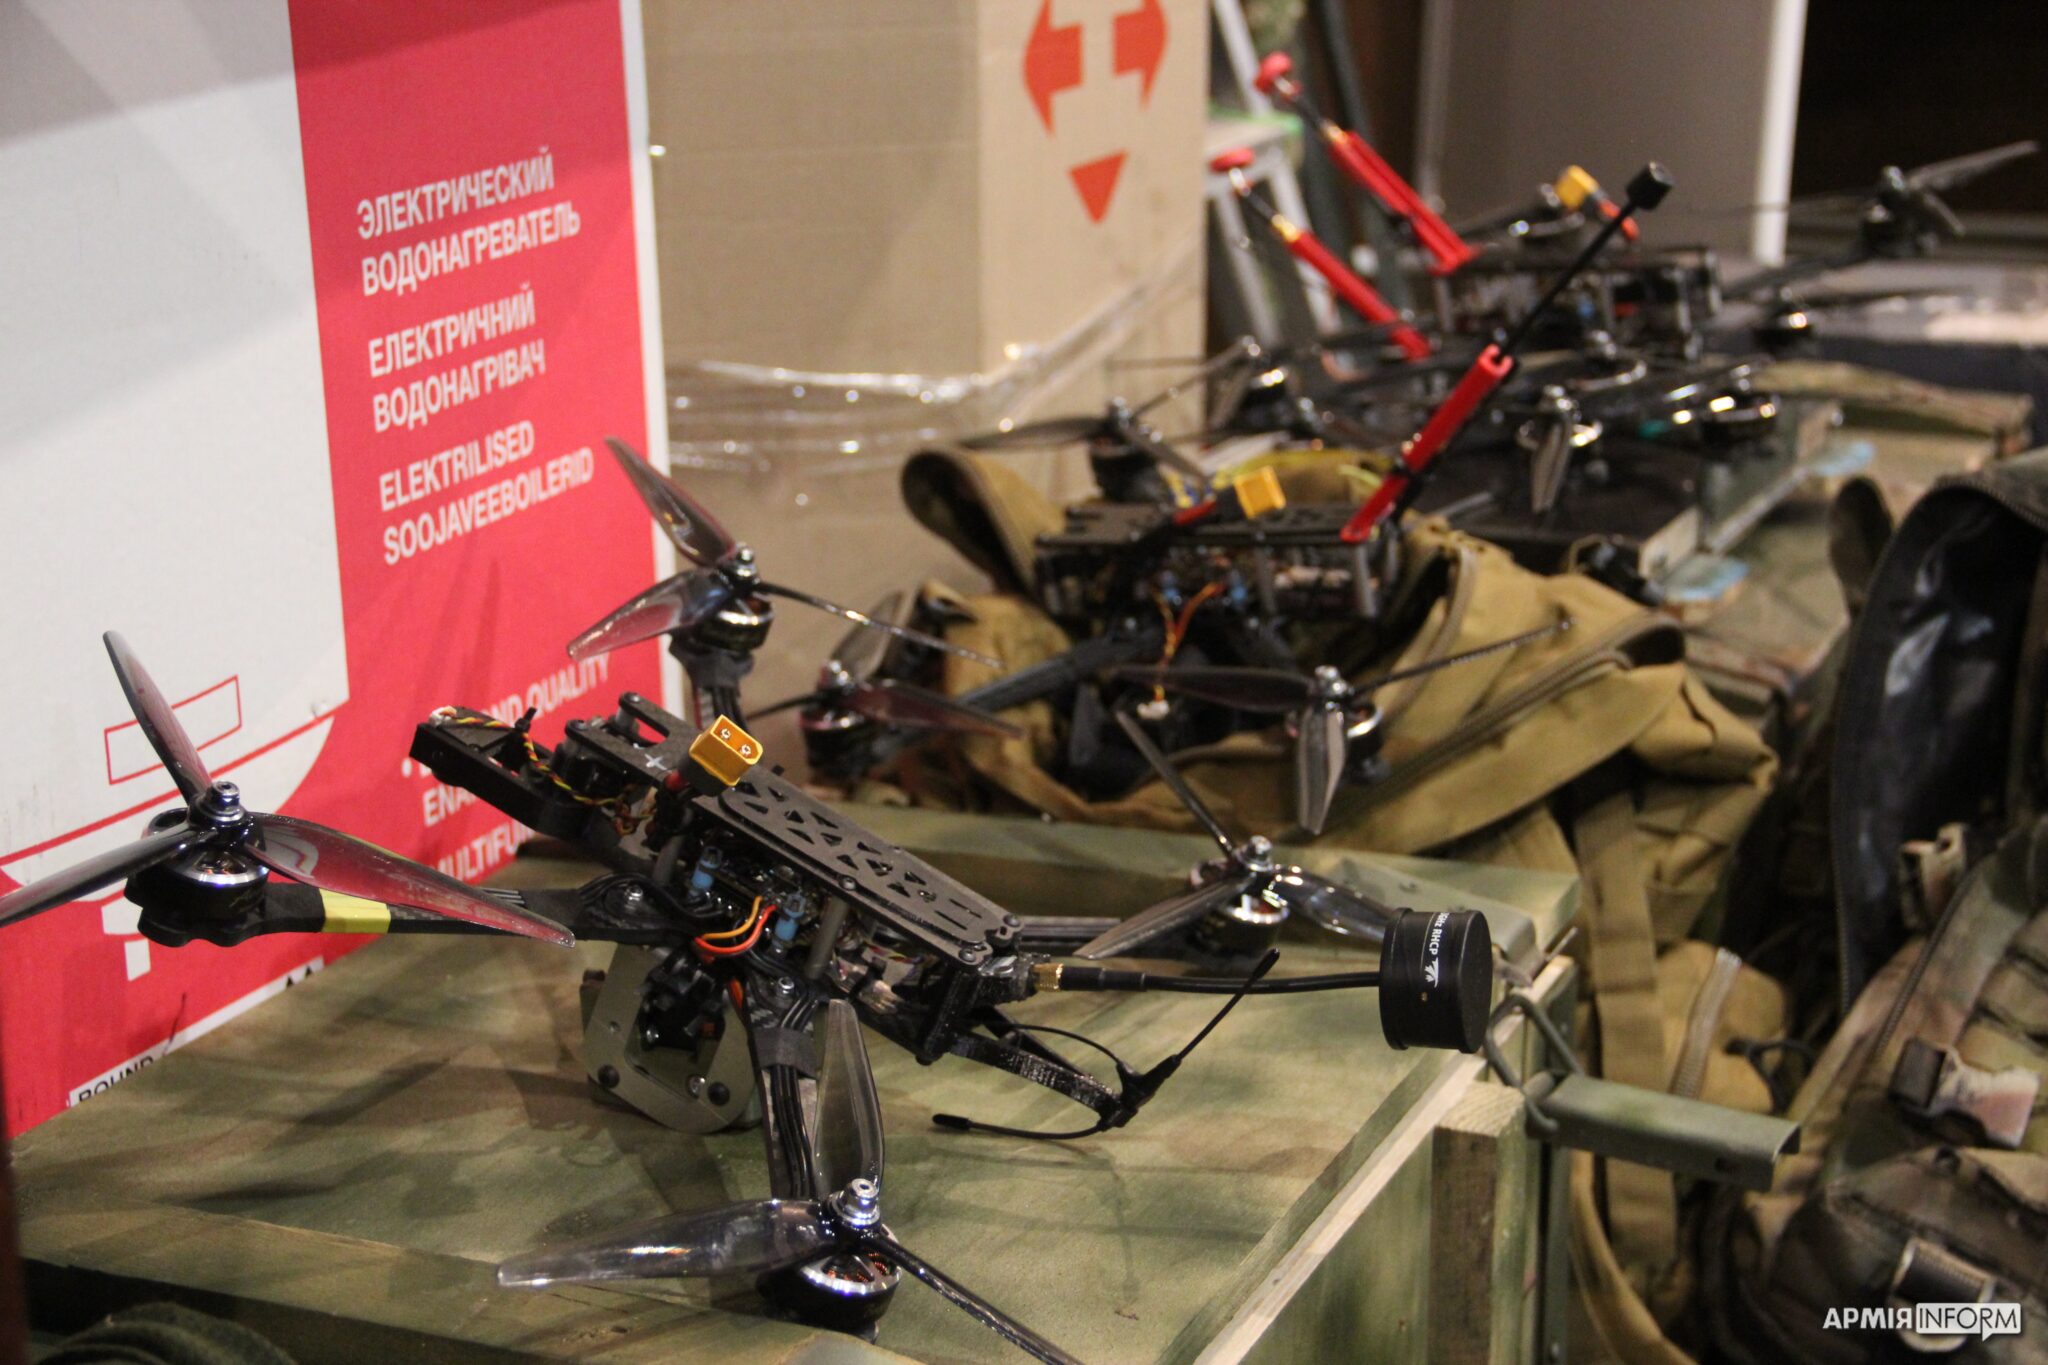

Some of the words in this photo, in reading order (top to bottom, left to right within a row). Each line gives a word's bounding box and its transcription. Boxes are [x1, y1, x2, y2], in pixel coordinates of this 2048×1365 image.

[357, 145, 555, 240] ЭЛЕКТРИЧЕСКИЙ
[362, 200, 581, 297] ВОДОНАГРЕВАТЕЛЬ
[368, 281, 536, 378] ЕЛЕКТРИЧНИЙ
[373, 338, 546, 433] ВОДОНАГРІВАЧ
[379, 420, 535, 512] ELEKTRILISED
[384, 447, 595, 565] SOOJAVEEBOILERID
[480, 694, 523, 728] ND
[526, 652, 610, 720] QUALITY
[1429, 928, 1443, 956] RHCP
